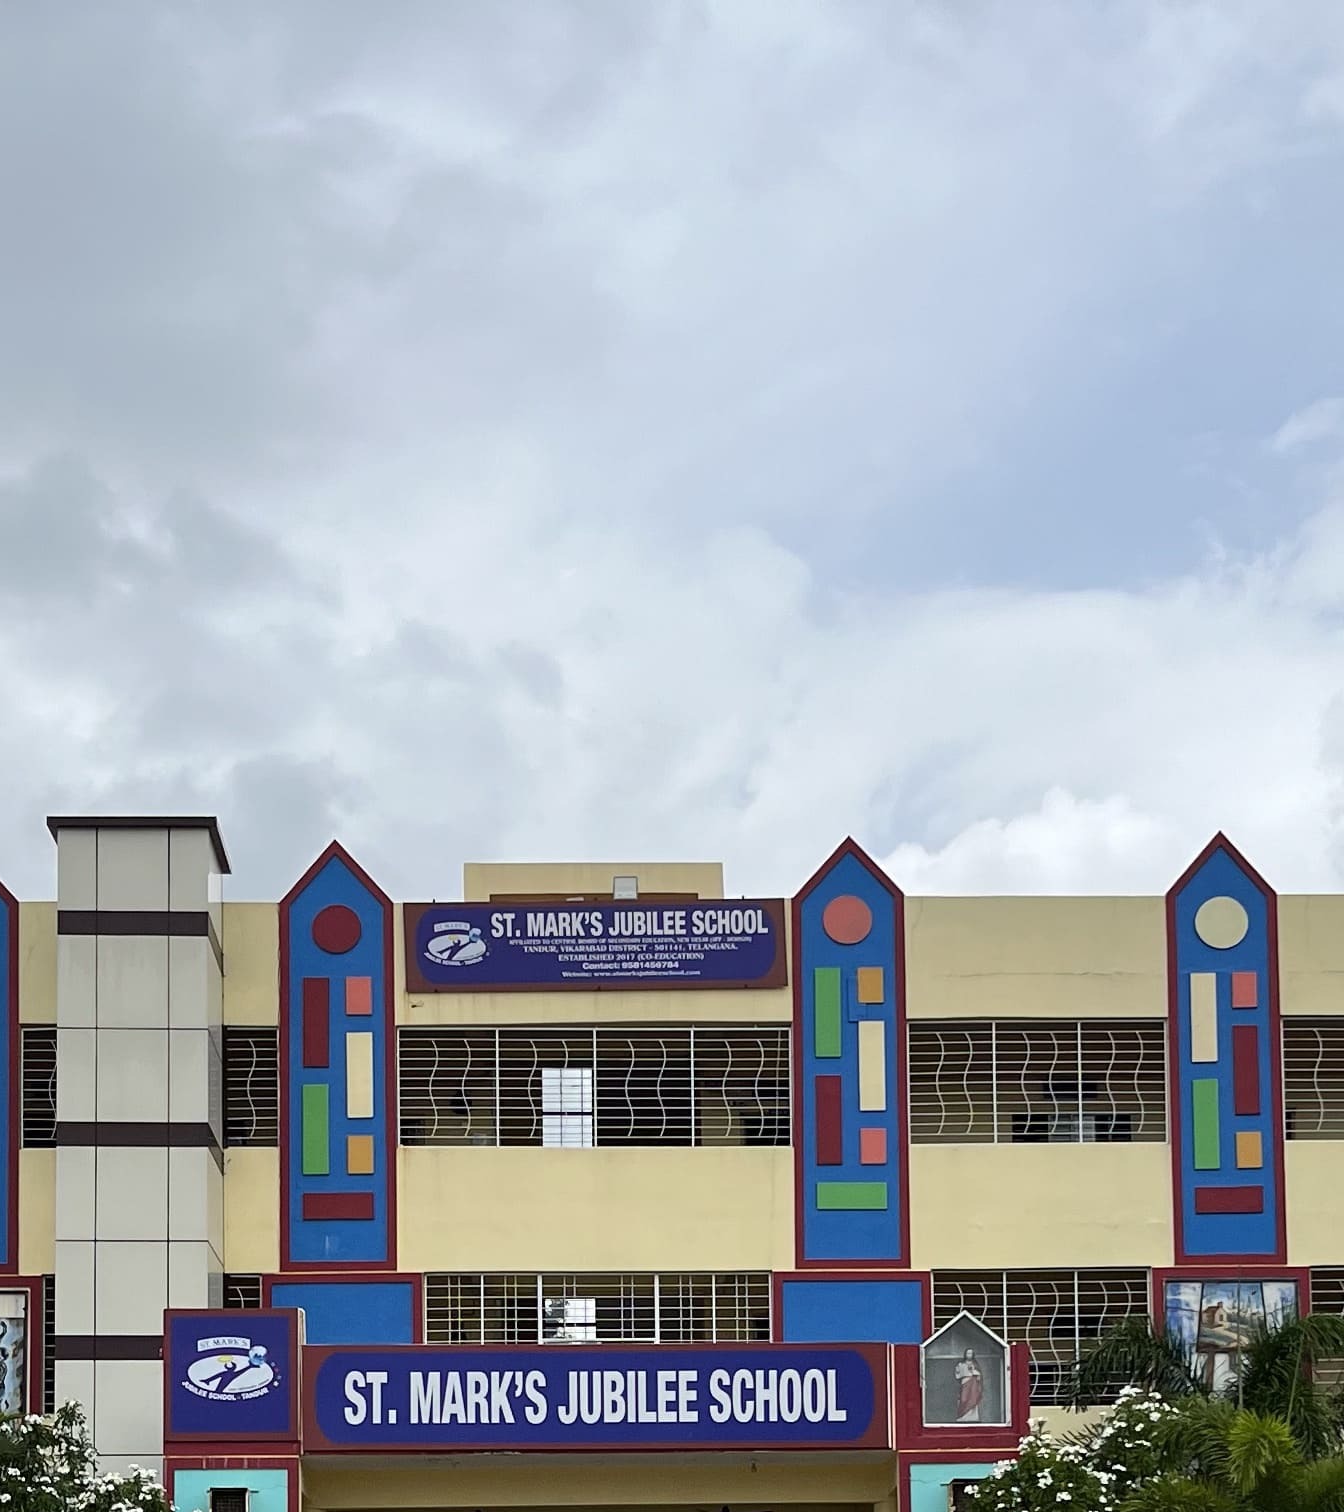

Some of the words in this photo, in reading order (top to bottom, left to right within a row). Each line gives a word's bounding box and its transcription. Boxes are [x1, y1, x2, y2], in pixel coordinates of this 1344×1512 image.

[491, 913, 521, 938] ST.
[527, 911, 603, 937] MARK’S
[608, 910, 686, 936] JUBILEE
[692, 909, 768, 935] SCHOOL
[523, 945, 558, 953] TANDUR,
[558, 953, 614, 961] ESTABLISHED
[582, 962, 620, 970] Contact:
[344, 1370, 397, 1425] ST.
[410, 1370, 547, 1425] MARK’S
[557, 1370, 698, 1424] JUBILEE
[709, 1368, 847, 1423] SCHOOL
